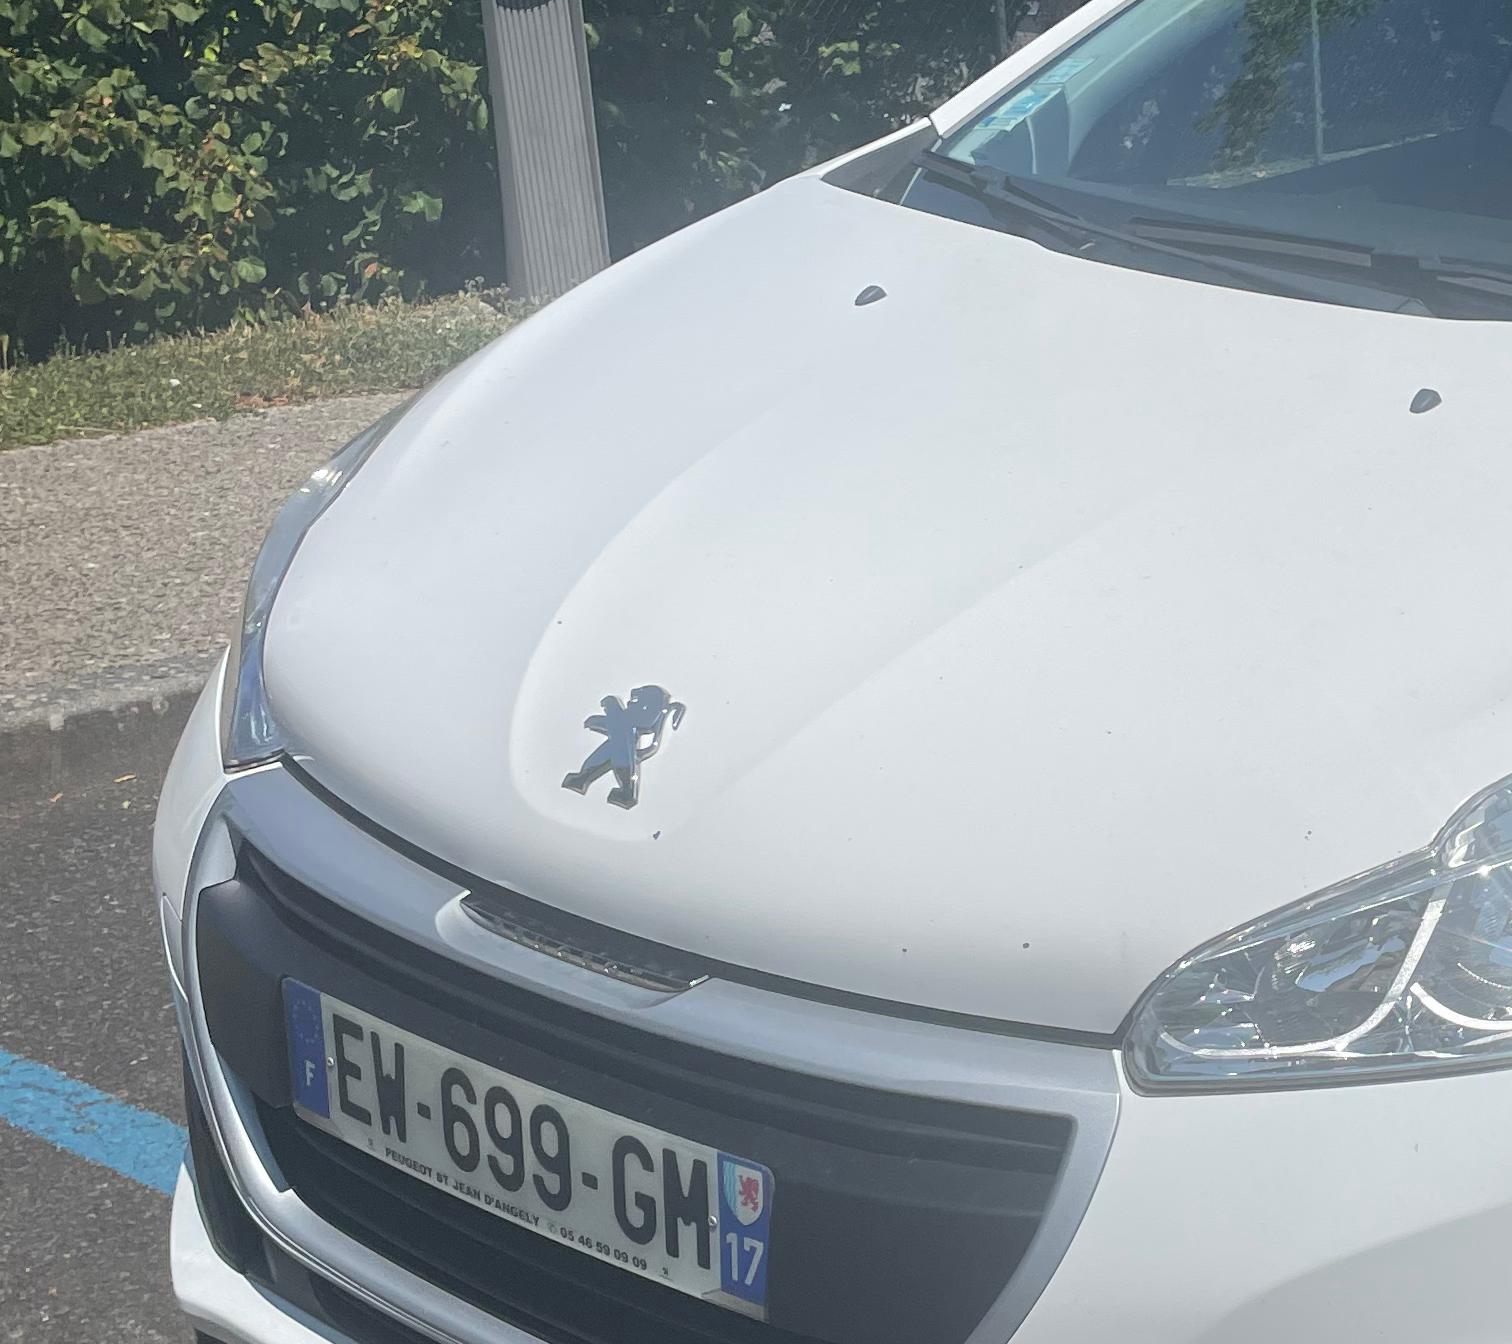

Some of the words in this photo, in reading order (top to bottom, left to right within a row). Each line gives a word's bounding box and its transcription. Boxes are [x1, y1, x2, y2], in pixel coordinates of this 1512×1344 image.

[304, 1059, 316, 1086] F
[332, 1013, 711, 1270] EW-699-GM
[385, 1147, 433, 1178] PEUGEOT
[452, 1179, 481, 1201] JEAN
[484, 1194, 540, 1226] D'ANGELY
[559, 1227, 575, 1242] 05
[578, 1235, 593, 1249] 46
[595, 1242, 611, 1256] 59
[613, 1249, 629, 1263] 09
[632, 1256, 648, 1270] 09
[725, 1232, 765, 1288] 17
